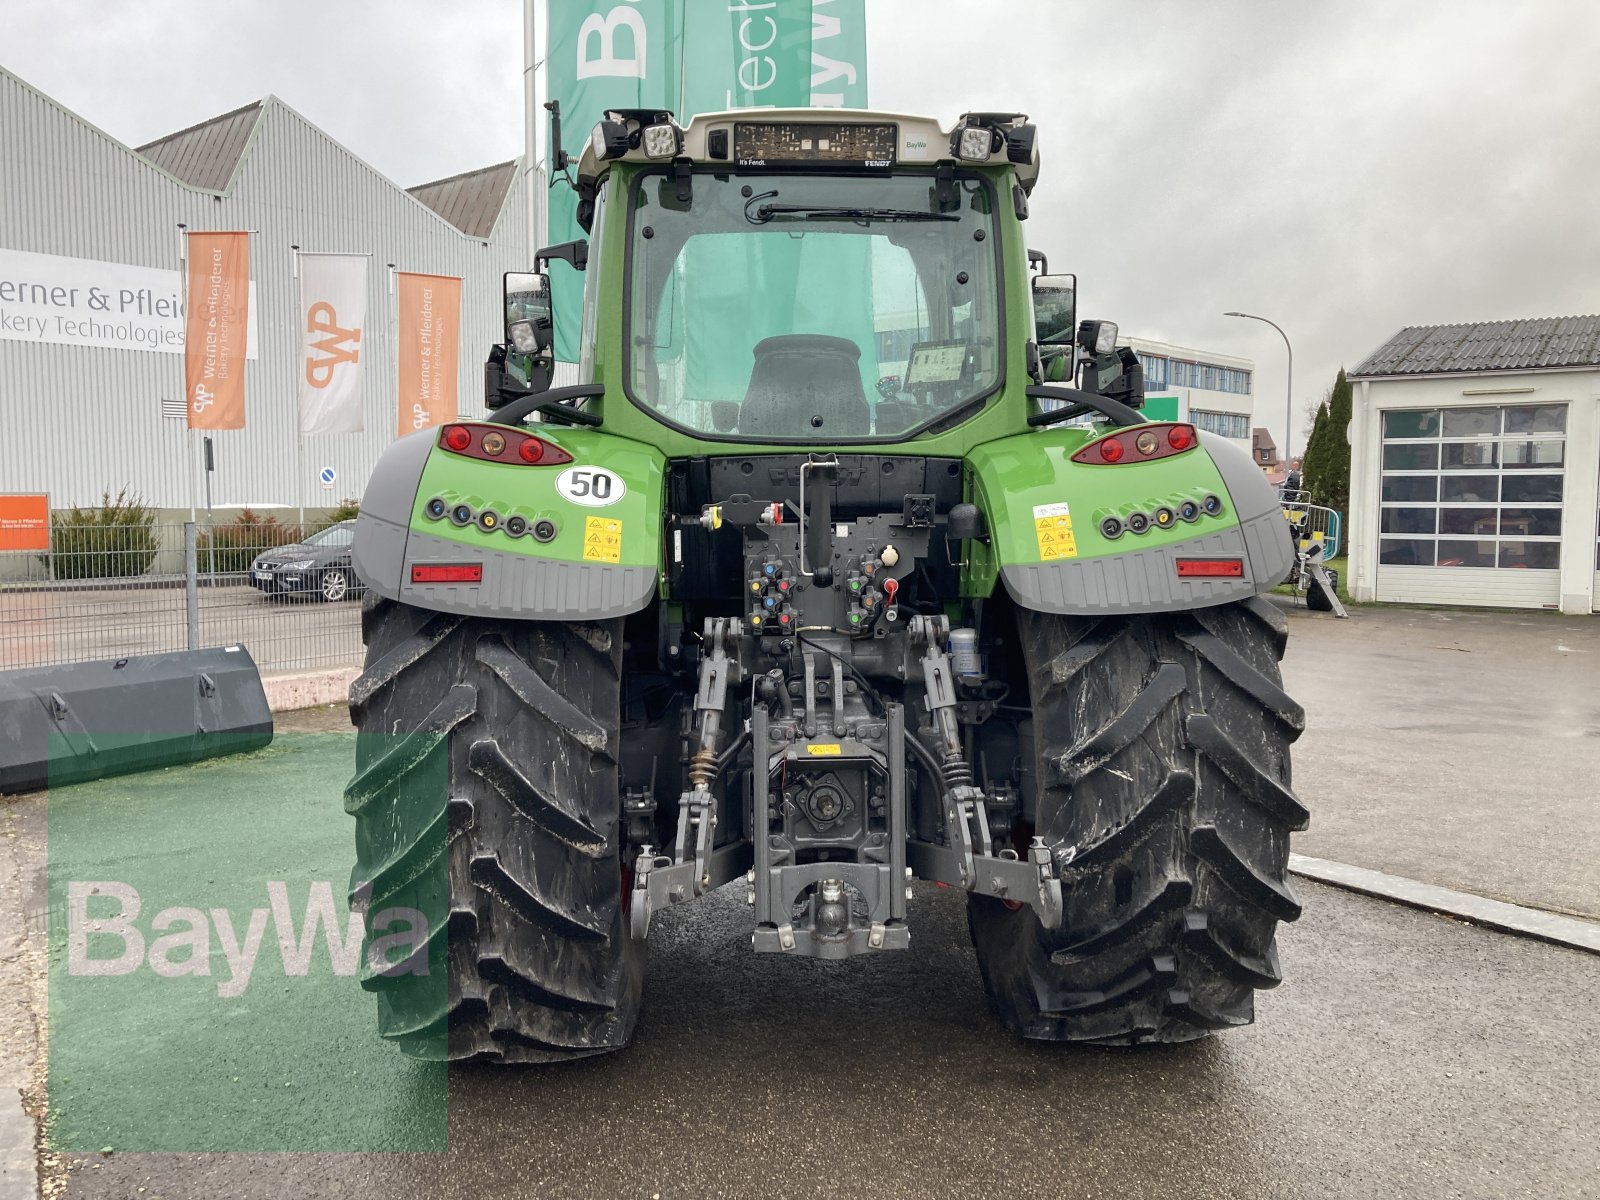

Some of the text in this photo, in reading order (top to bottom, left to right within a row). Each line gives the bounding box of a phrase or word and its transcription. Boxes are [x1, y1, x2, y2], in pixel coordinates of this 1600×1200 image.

[576, 0, 646, 80] B
[0, 280, 78, 308] erner
[87, 286, 110, 311] &
[0, 308, 185, 348] kery Technologies
[208, 316, 217, 328] &
[419, 287, 433, 399] Werner & Pfleiderer
[570, 471, 612, 499] 50
